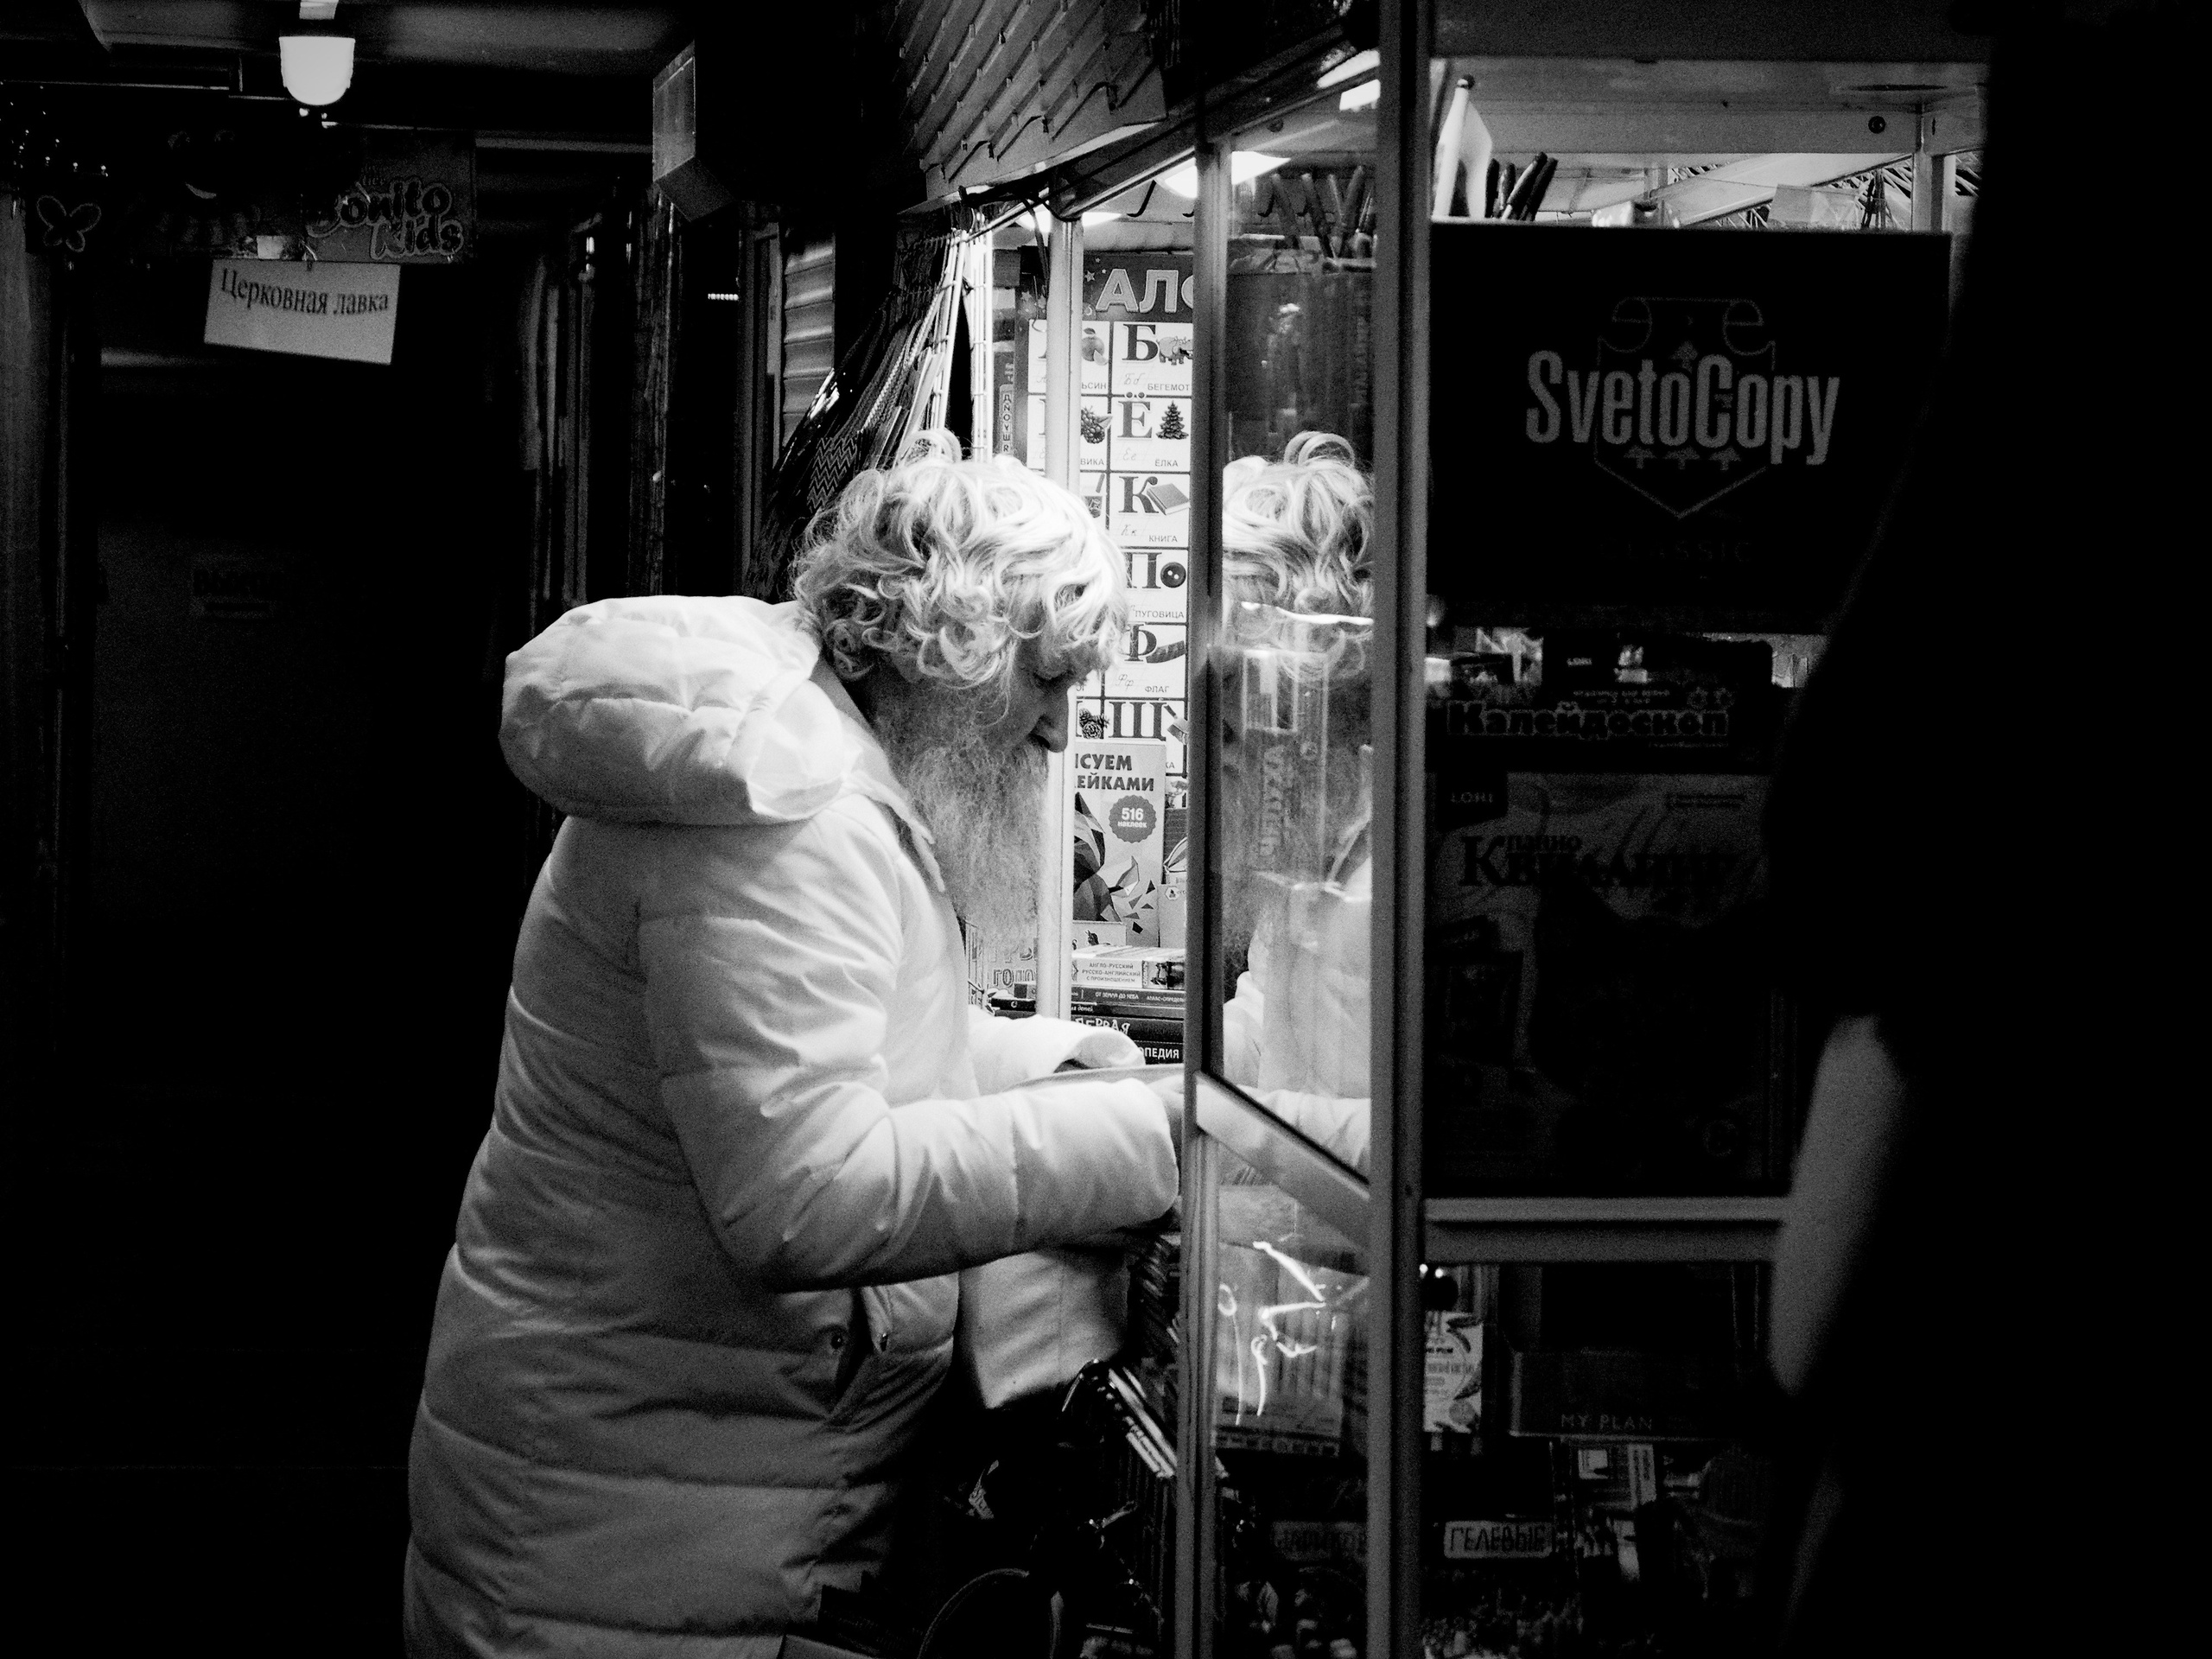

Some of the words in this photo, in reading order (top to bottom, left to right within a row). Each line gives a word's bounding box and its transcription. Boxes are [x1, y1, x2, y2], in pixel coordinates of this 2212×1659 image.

[221, 267, 327, 315] Церковная
[333, 293, 388, 315] лавка
[1122, 323, 1159, 361] Б
[1081, 381, 1107, 390] ЬСИН
[1147, 383, 1190, 391] БЕГЕМОТ
[1526, 350, 1840, 467] SvetoCopy
[1118, 476, 1159, 514] К
[1135, 610, 1185, 620] ПУГОВИЦА
[1145, 685, 1170, 694] ФЛАГ
[1447, 700, 1730, 741] Калейдоскоп
[1076, 772, 1154, 791] ЕЙКАМИ
[1122, 808, 1144, 821] 516
[1560, 1414, 1590, 1428] MY
[1599, 1414, 1653, 1431] PLAN
[1451, 1525, 1545, 1553] ГЕЛЕВЫЕ
